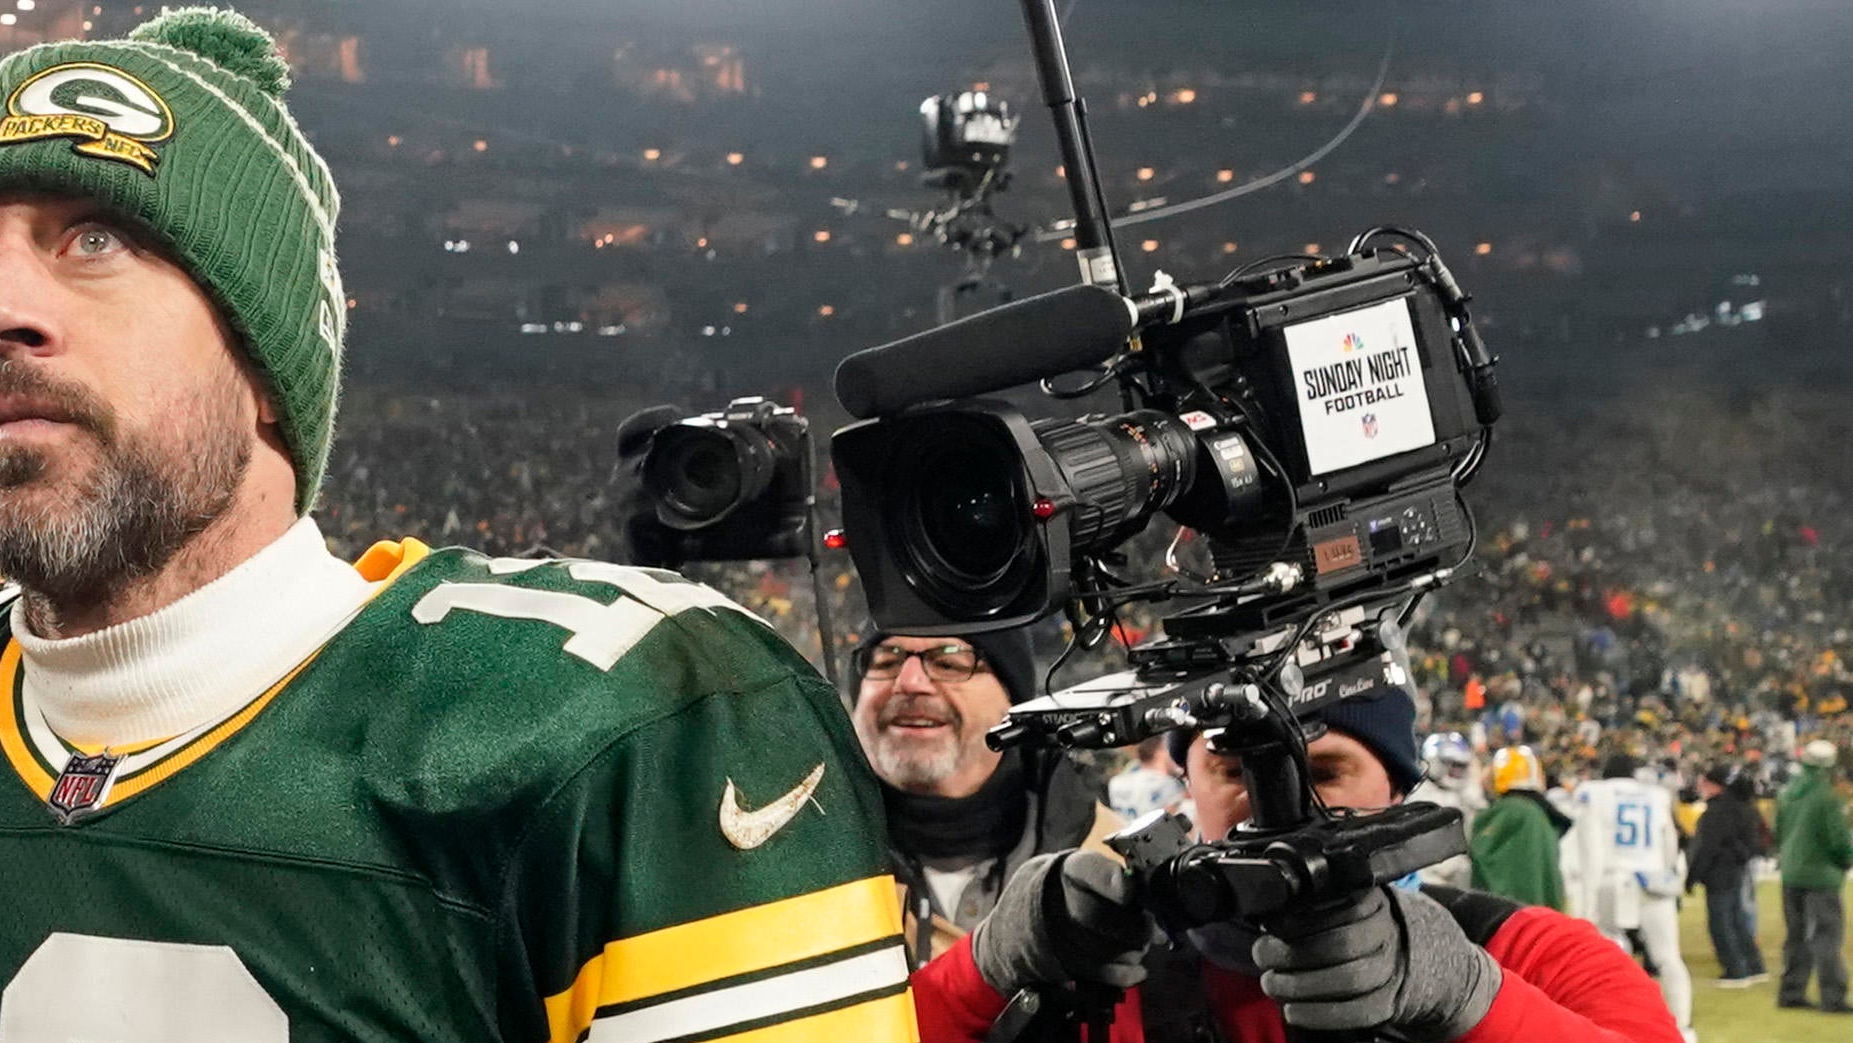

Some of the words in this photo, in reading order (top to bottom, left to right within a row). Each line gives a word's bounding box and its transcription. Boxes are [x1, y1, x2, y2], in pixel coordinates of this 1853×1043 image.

[3, 116, 103, 138] PACKERS
[1303, 357, 1365, 402] SUNDAY
[1366, 346, 1412, 386] NIGHT
[1324, 383, 1405, 416] FOOTBALL
[54, 774, 99, 807] NFL
[1614, 803, 1652, 847] 51
